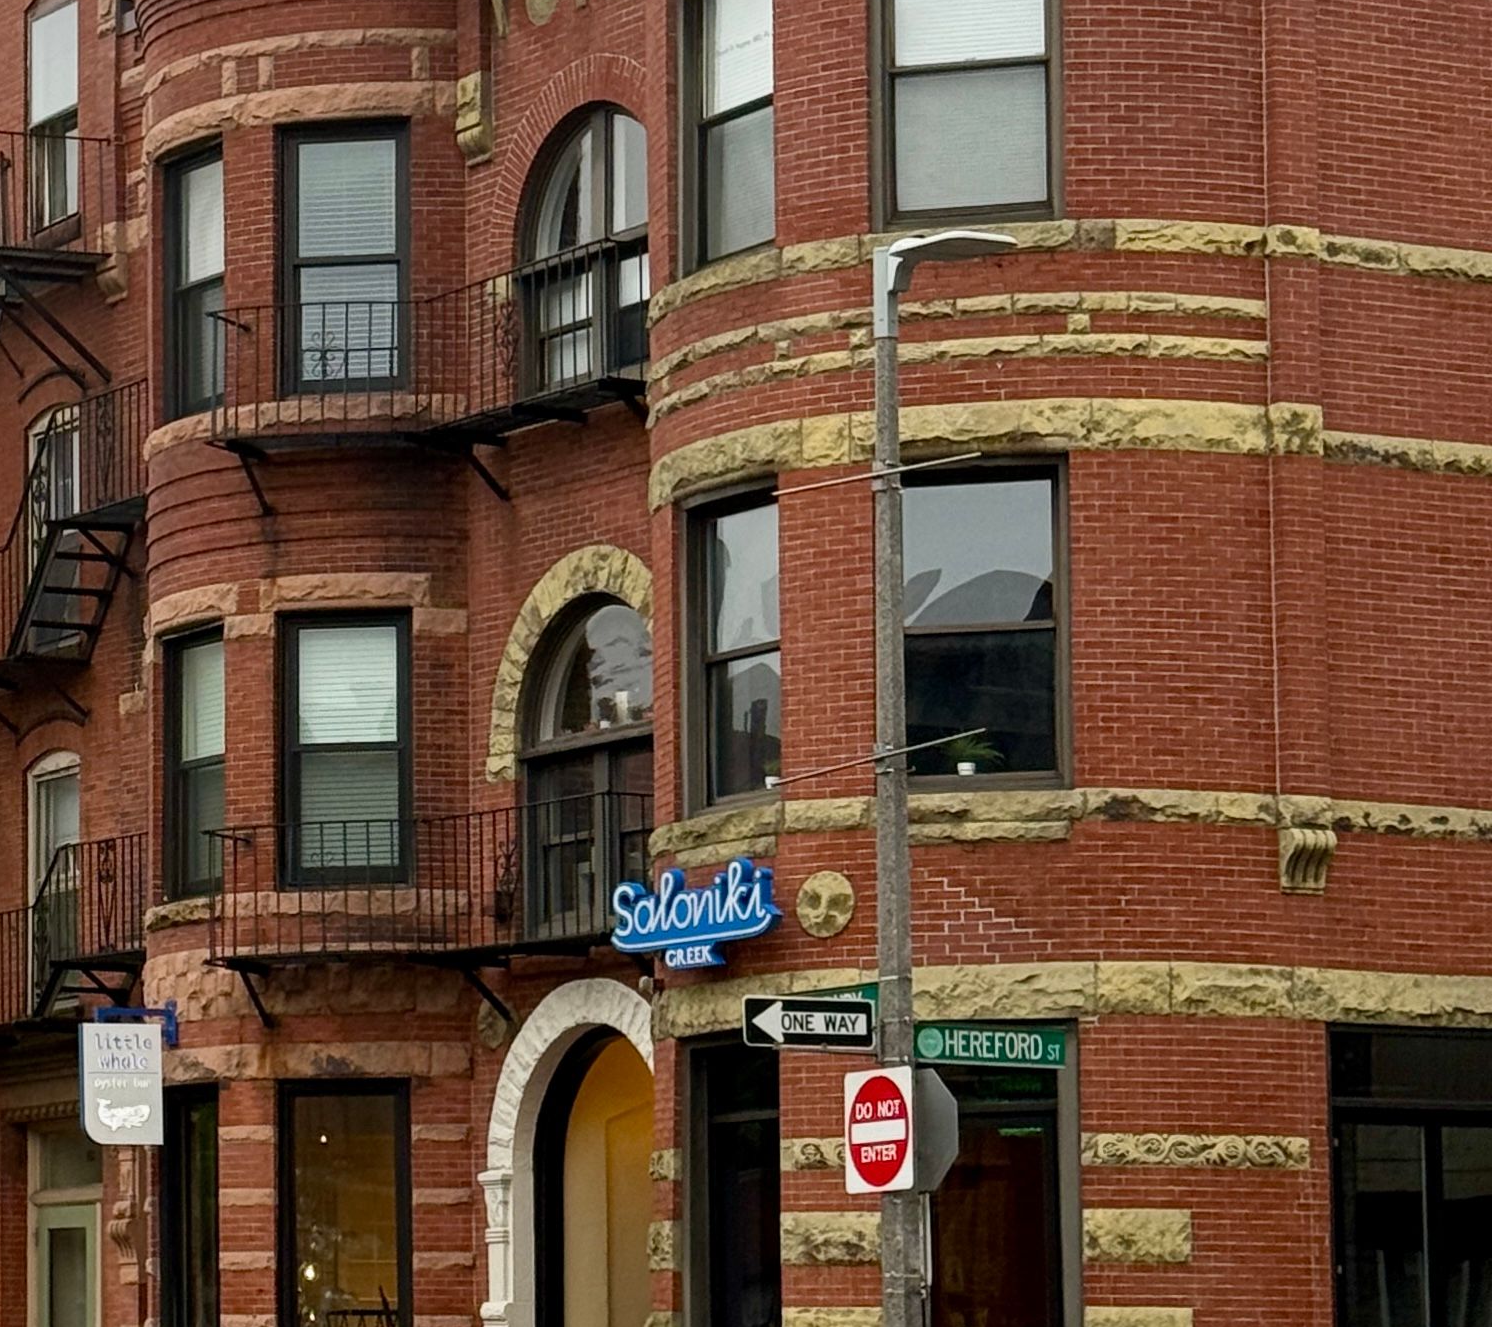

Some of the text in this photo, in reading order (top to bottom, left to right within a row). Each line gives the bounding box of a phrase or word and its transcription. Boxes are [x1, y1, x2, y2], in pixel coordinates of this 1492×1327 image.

[612, 861, 768, 939] Saloniki
[664, 946, 714, 966] GREEK
[781, 1013, 859, 1032] ONE WAY
[95, 1033, 152, 1050] little
[944, 1029, 1060, 1061] HEREFORD ST
[99, 1052, 149, 1069] whale
[94, 1077, 150, 1090] oyster bar
[855, 1099, 901, 1120] DO NOT
[861, 1144, 897, 1163] ENTER
